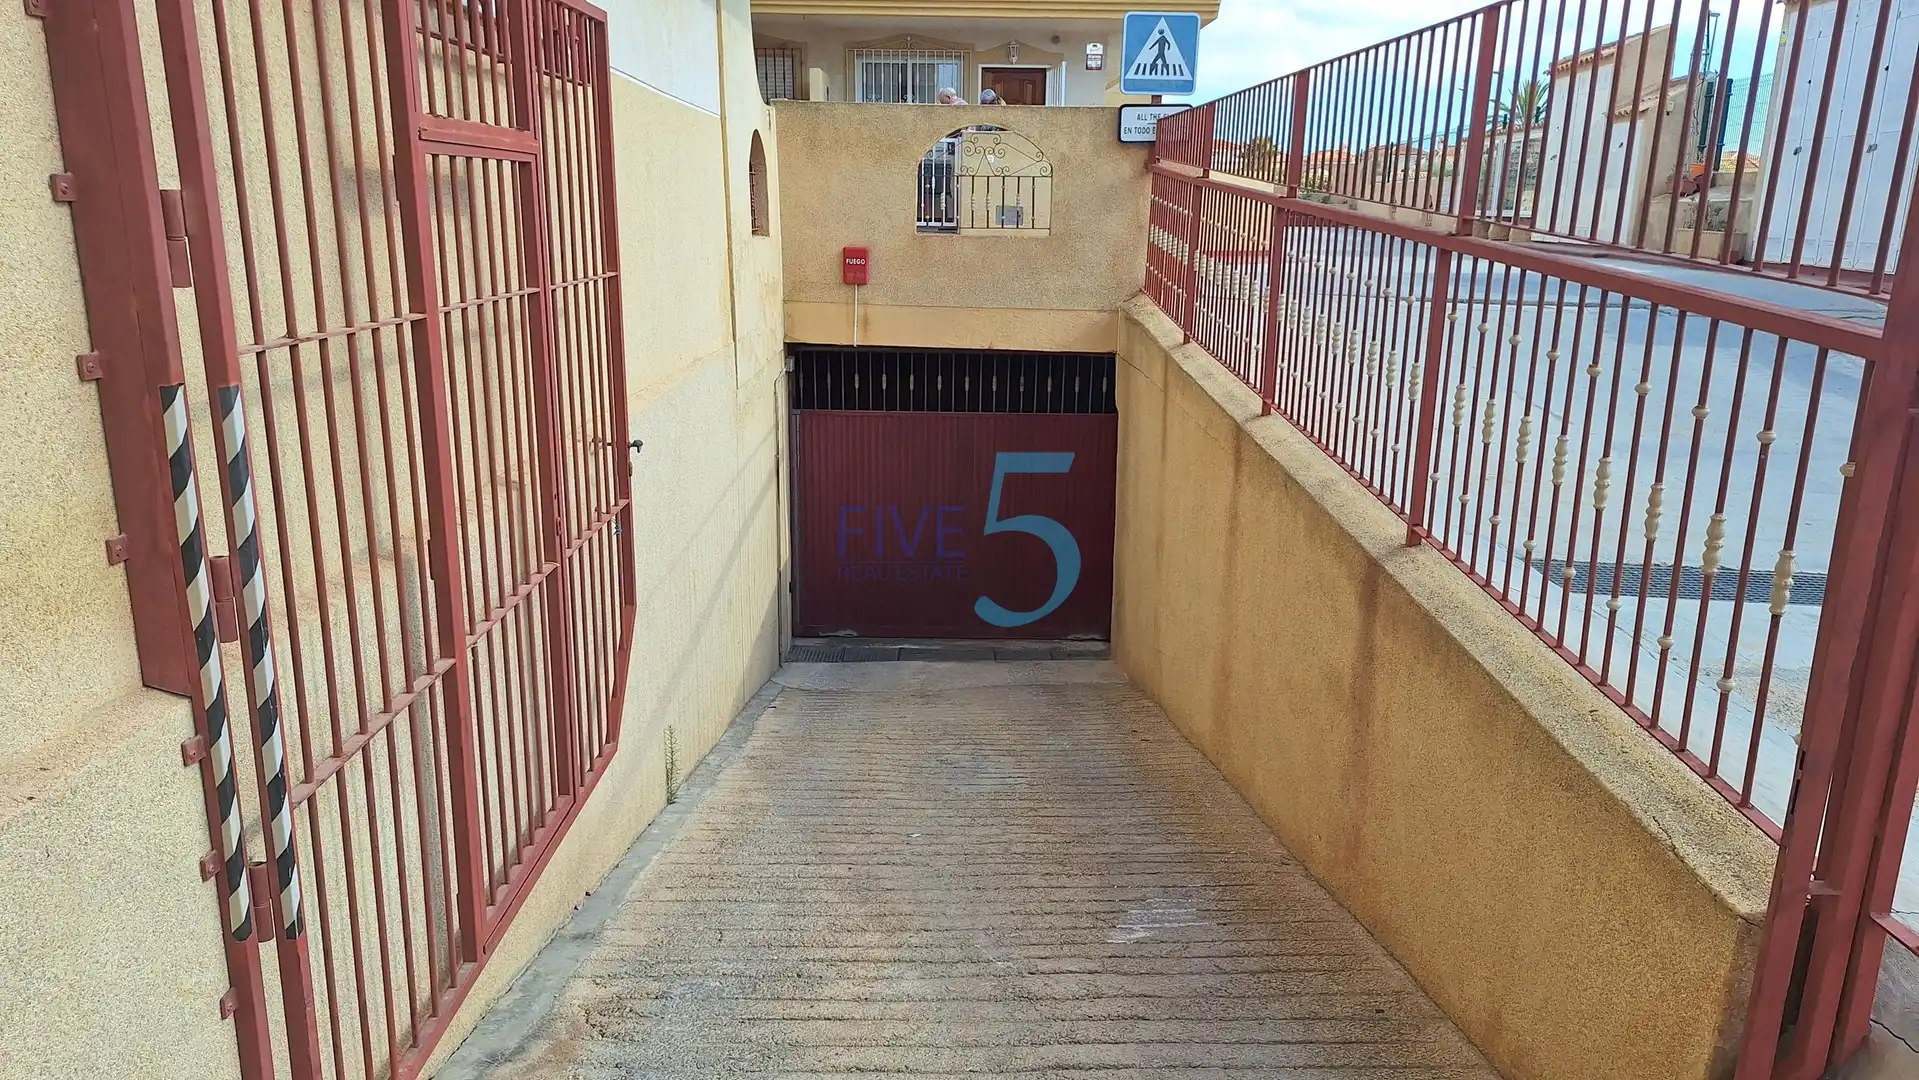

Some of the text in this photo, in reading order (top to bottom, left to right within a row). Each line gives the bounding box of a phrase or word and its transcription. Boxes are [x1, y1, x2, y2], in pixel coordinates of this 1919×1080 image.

[1137, 113, 1148, 121] ALL
[1124, 126, 1132, 134] EN
[1134, 126, 1150, 134] TODO
